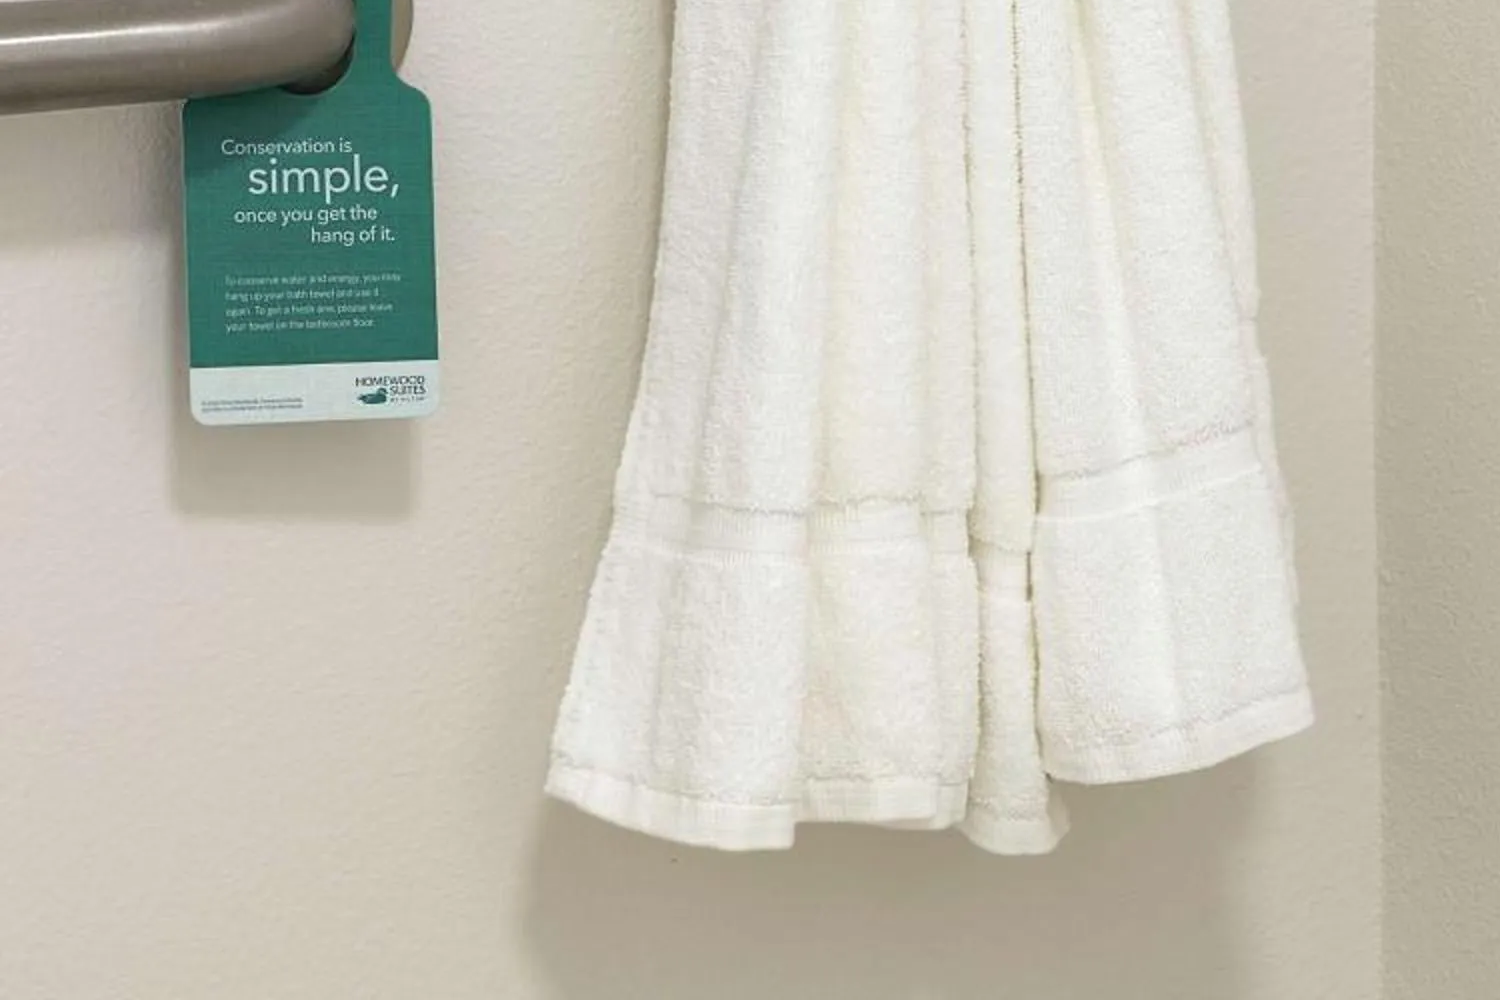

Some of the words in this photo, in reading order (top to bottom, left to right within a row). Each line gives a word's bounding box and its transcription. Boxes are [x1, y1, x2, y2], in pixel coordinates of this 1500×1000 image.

[221, 137, 335, 155] Conservation
[339, 137, 352, 153] is
[248, 153, 399, 204] simple,
[234, 208, 277, 223] once
[281, 208, 312, 227] you
[317, 206, 346, 225] get
[349, 204, 377, 221] the
[311, 227, 354, 246] hang
[359, 226, 377, 242] of
[380, 225, 396, 241] it.
[309, 287, 334, 298] towel
[355, 375, 425, 387] HOMEWOOD
[389, 385, 426, 395] SUITES
